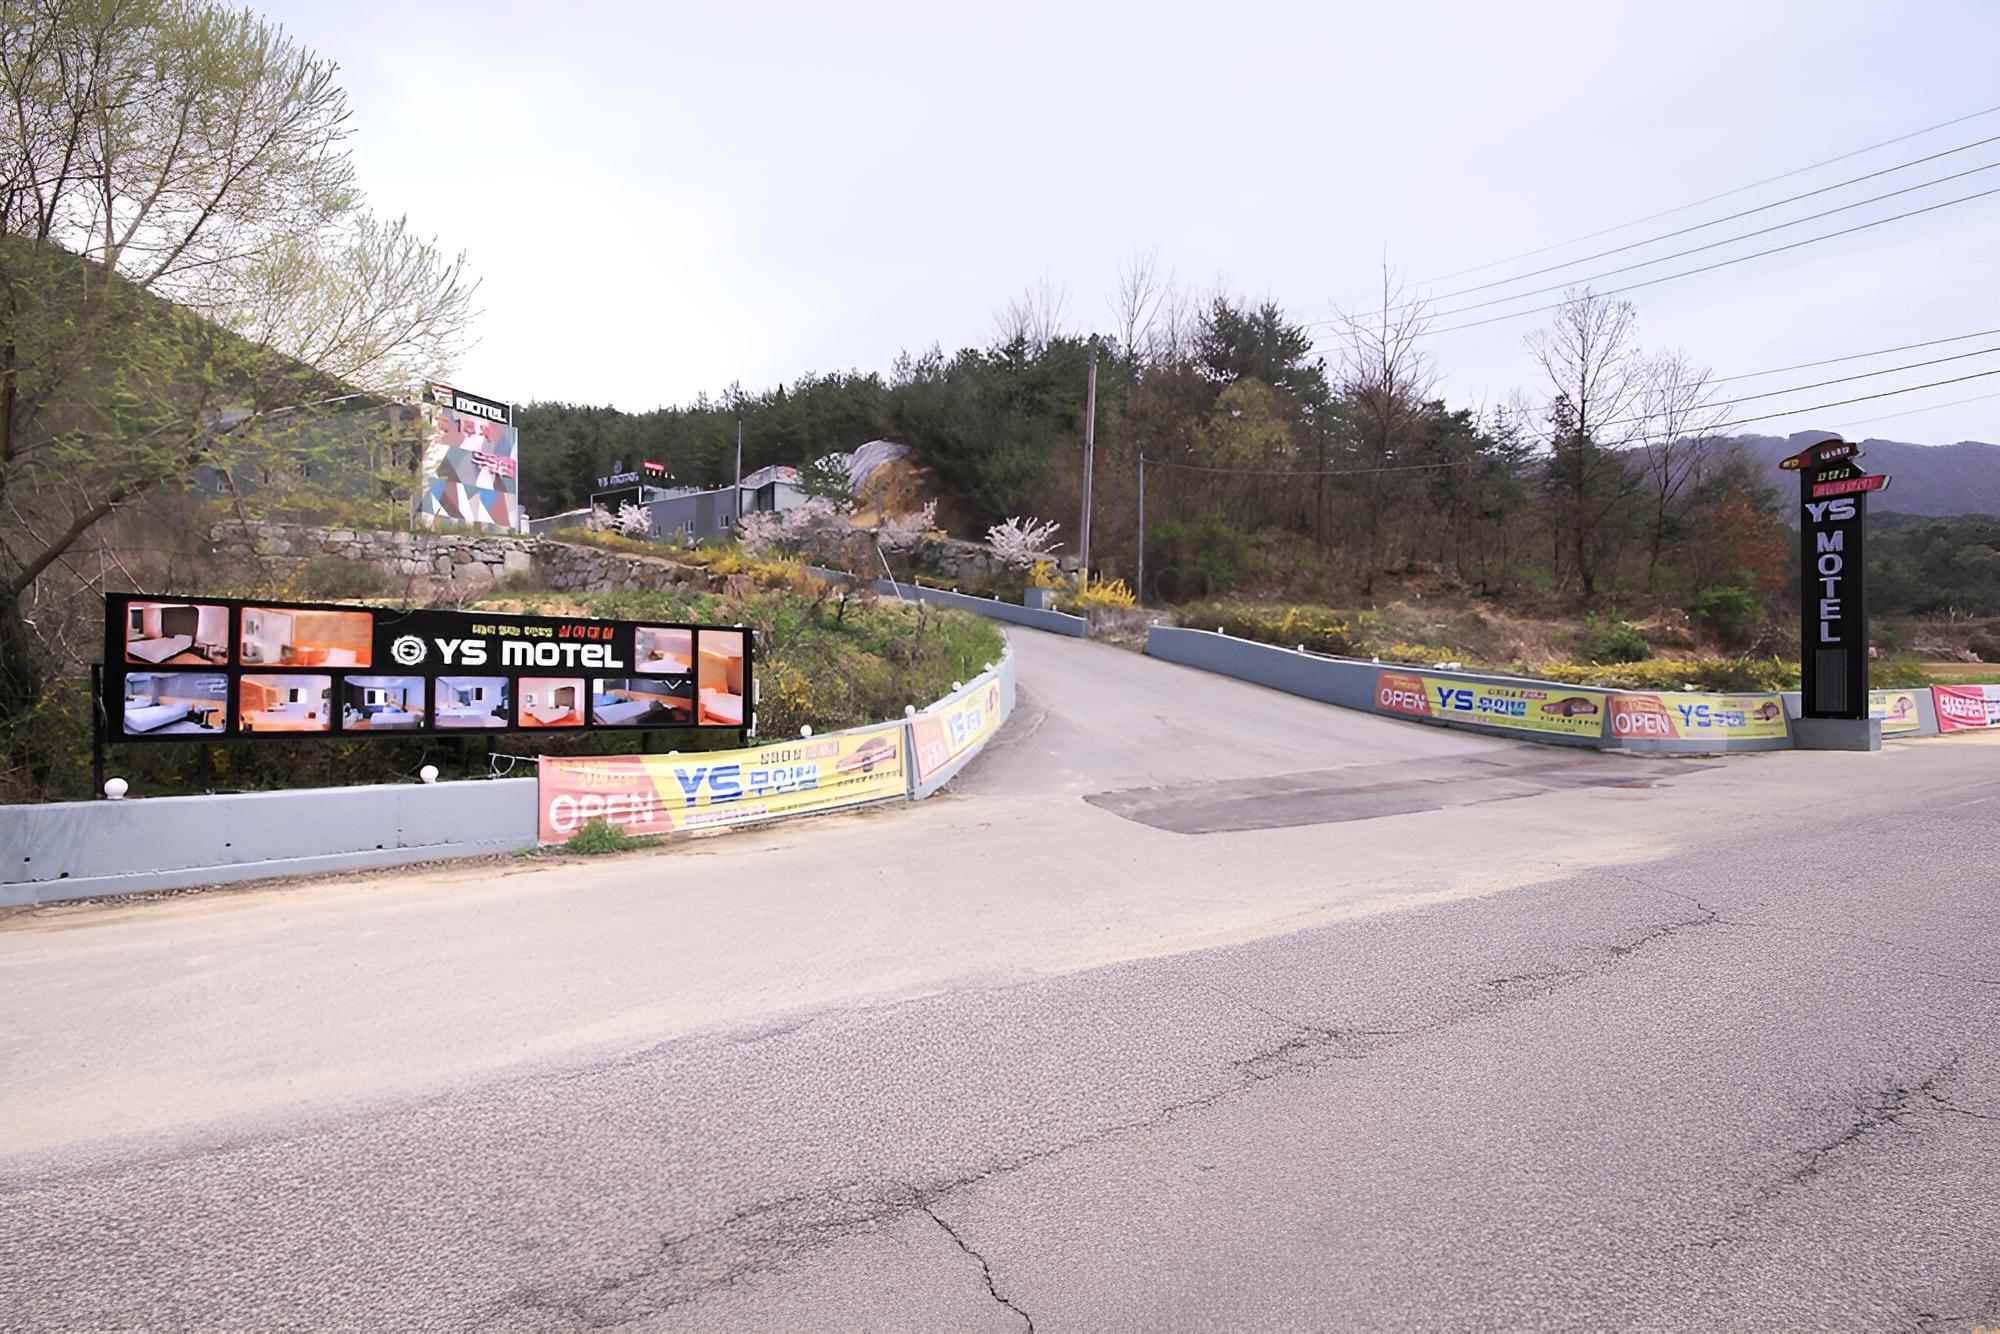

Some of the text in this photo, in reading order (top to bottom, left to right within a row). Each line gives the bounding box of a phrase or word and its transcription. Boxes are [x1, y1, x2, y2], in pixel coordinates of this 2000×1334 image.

[1805, 498, 1856, 523] YS
[1816, 530, 1844, 643] MOTEL
[435, 638, 487, 666] YS
[1380, 687, 1426, 711] OPEN
[1436, 686, 1474, 711] YS
[1615, 712, 1670, 734] OPEN
[1677, 703, 1712, 728] YS
[673, 764, 743, 808] YS
[549, 790, 655, 833] OPEN
